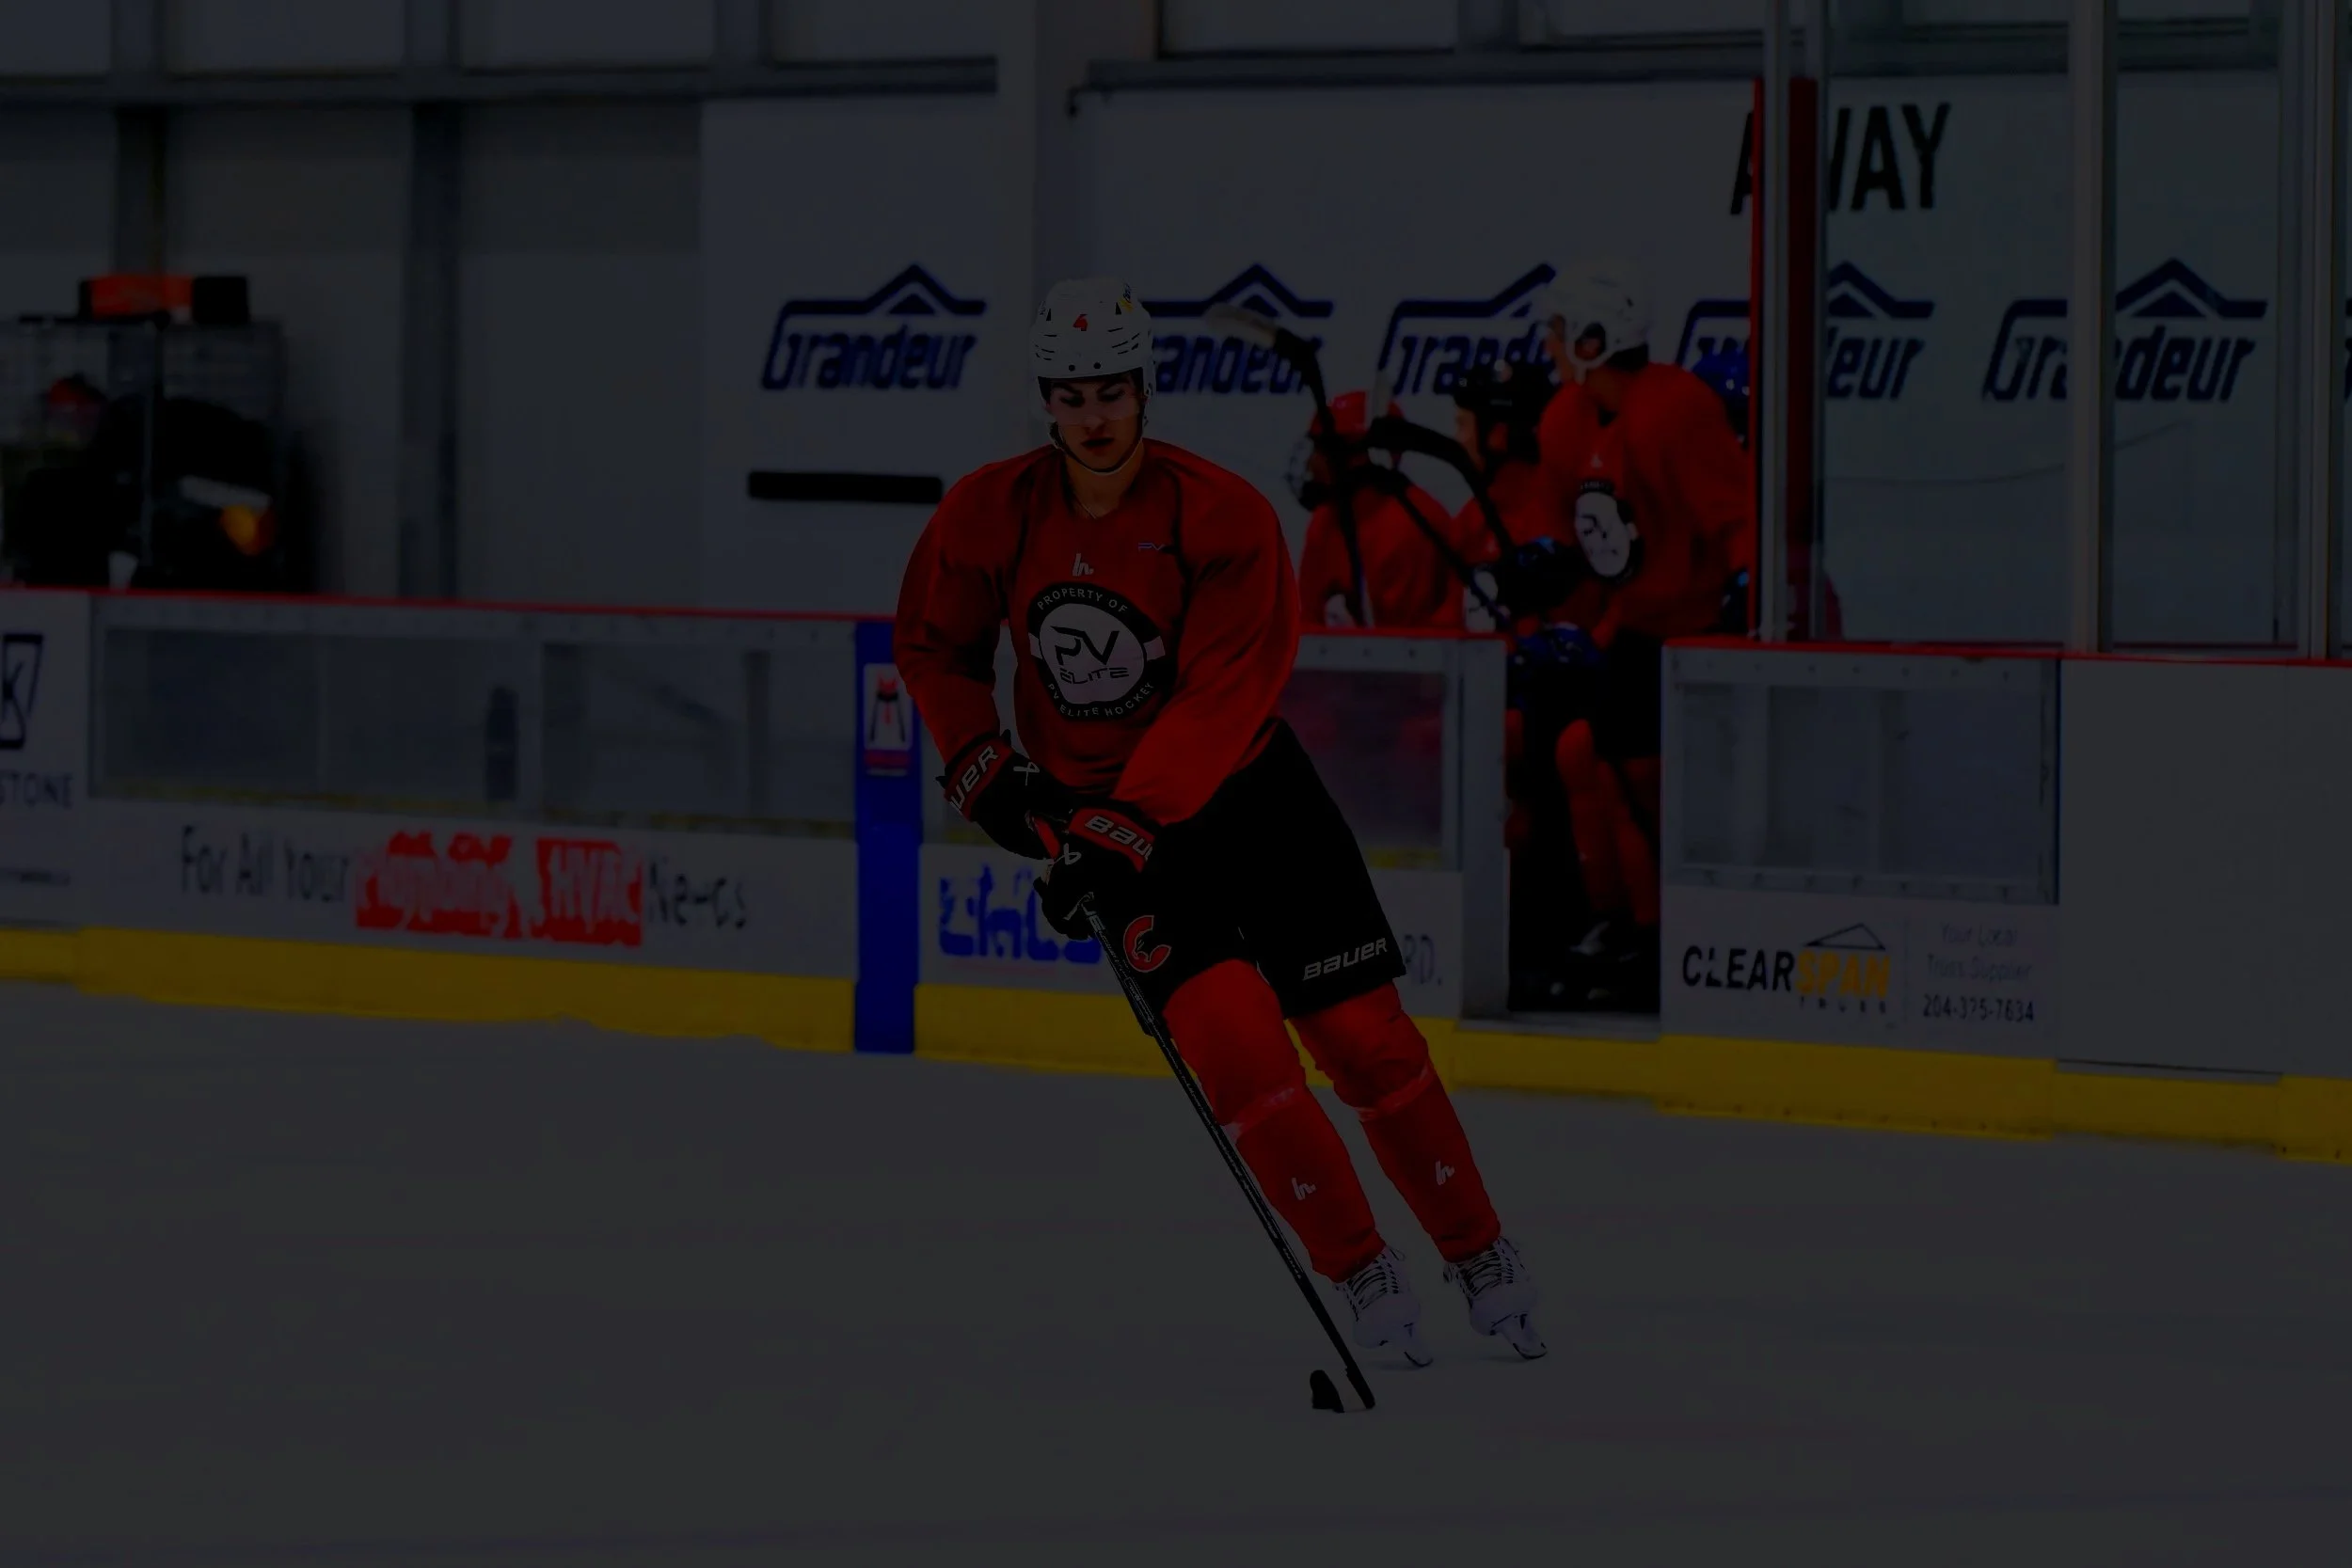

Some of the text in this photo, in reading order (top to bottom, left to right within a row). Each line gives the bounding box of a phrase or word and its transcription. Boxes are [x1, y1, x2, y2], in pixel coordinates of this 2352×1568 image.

[761, 264, 986, 390] Grandeur
[1037, 588, 1128, 613] PROPERTY OF
[1050, 626, 1120, 665] PV
[1060, 667, 1130, 685] ELITE
[1059, 705, 1099, 717] ELITE
[1105, 681, 1154, 717] HOCKEY
[182, 825, 228, 895] For
[237, 832, 274, 896] All
[1302, 937, 1388, 981] BAUER
